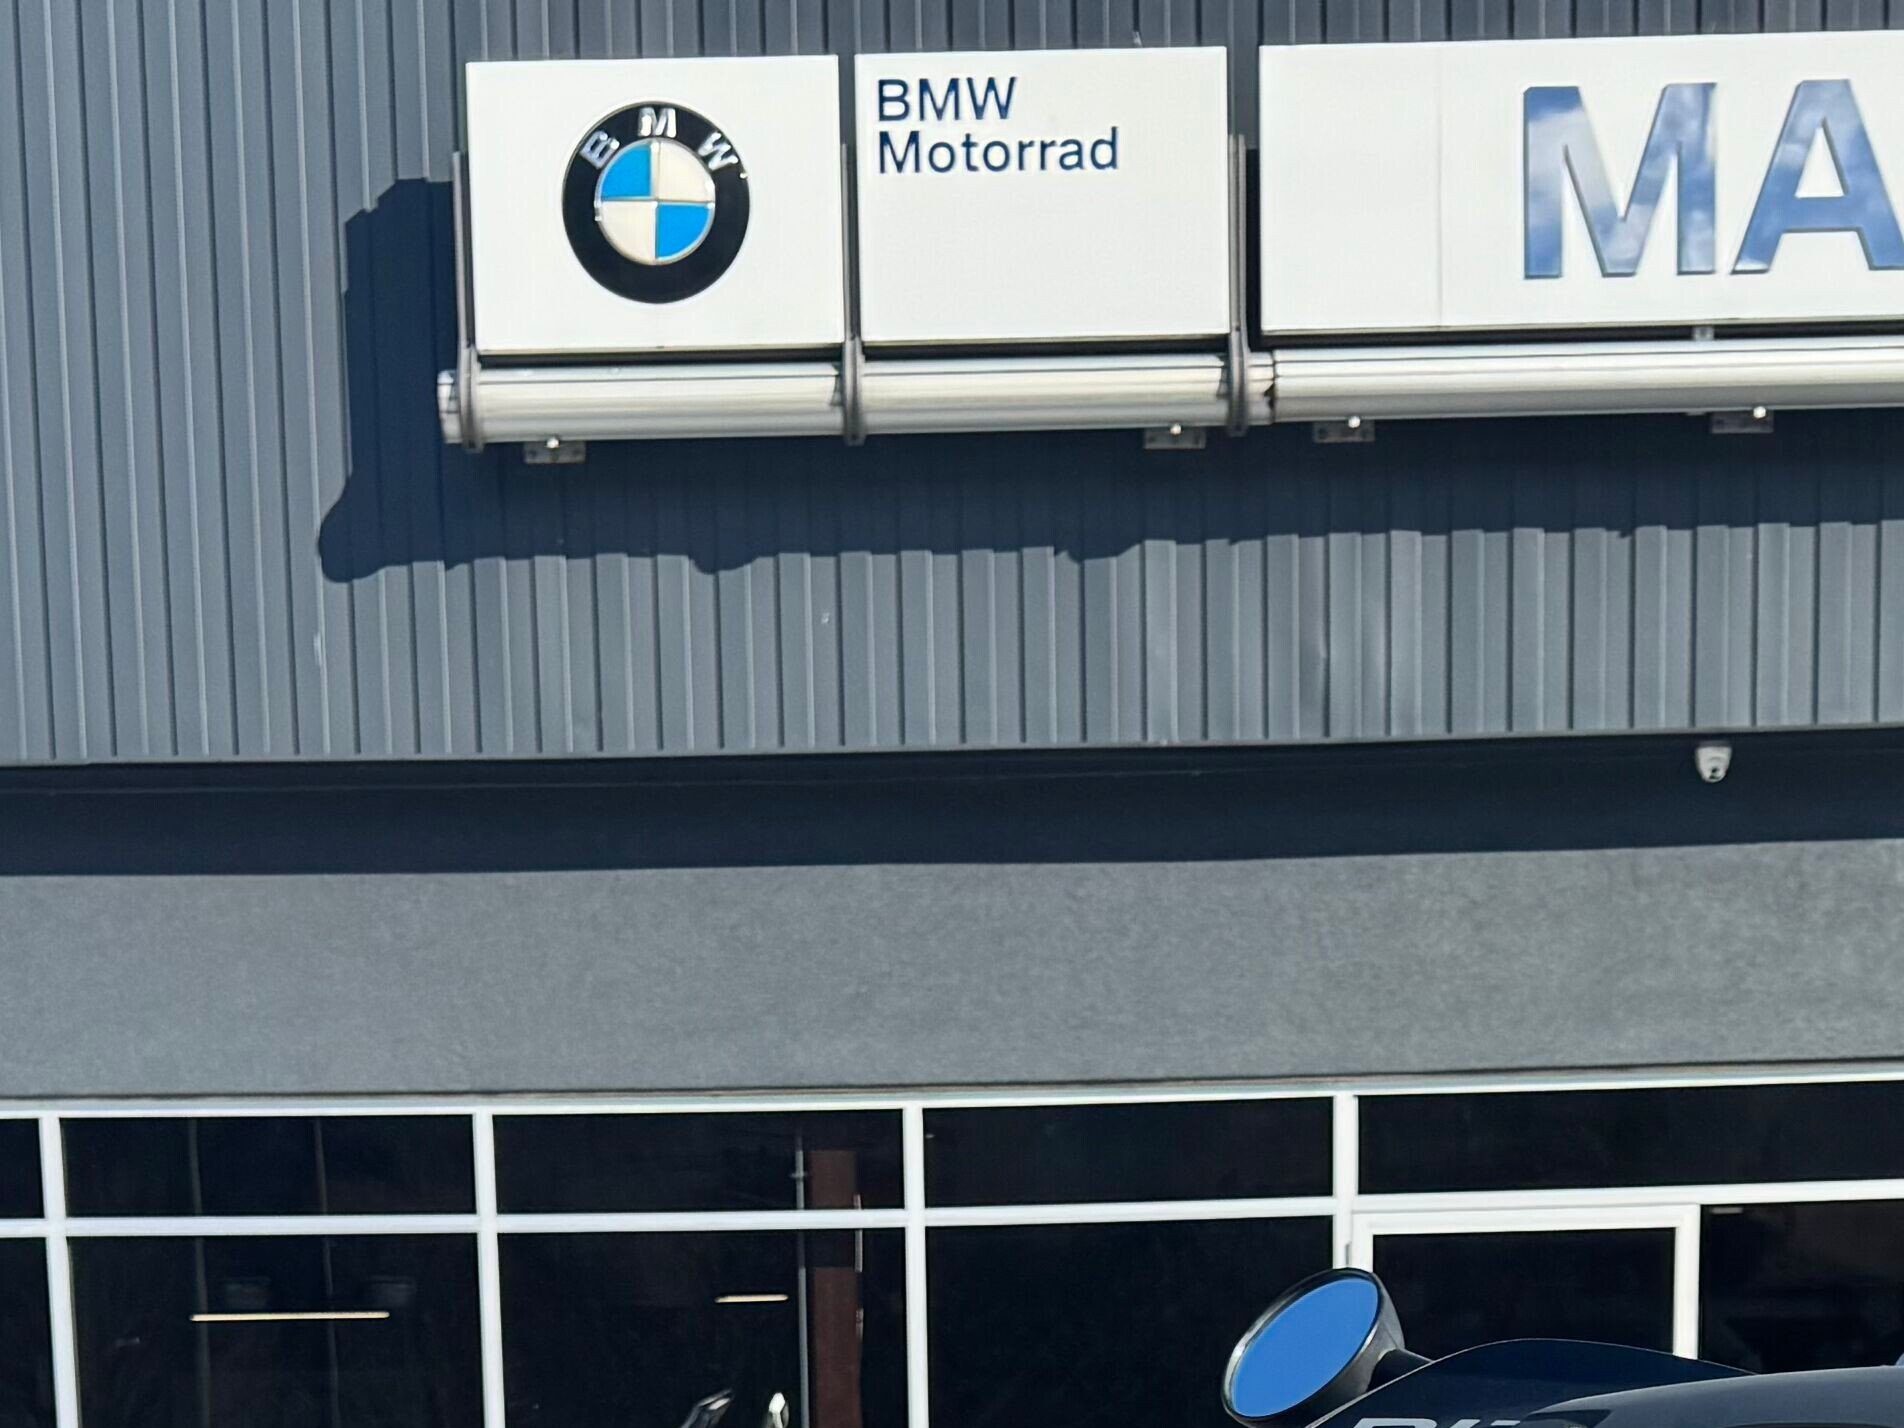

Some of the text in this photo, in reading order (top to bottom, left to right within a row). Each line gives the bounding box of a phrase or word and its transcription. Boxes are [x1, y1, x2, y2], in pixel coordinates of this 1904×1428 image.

[877, 76, 1017, 122] BMW
[581, 106, 739, 170] BMW
[878, 126, 1119, 174] Motorrad
